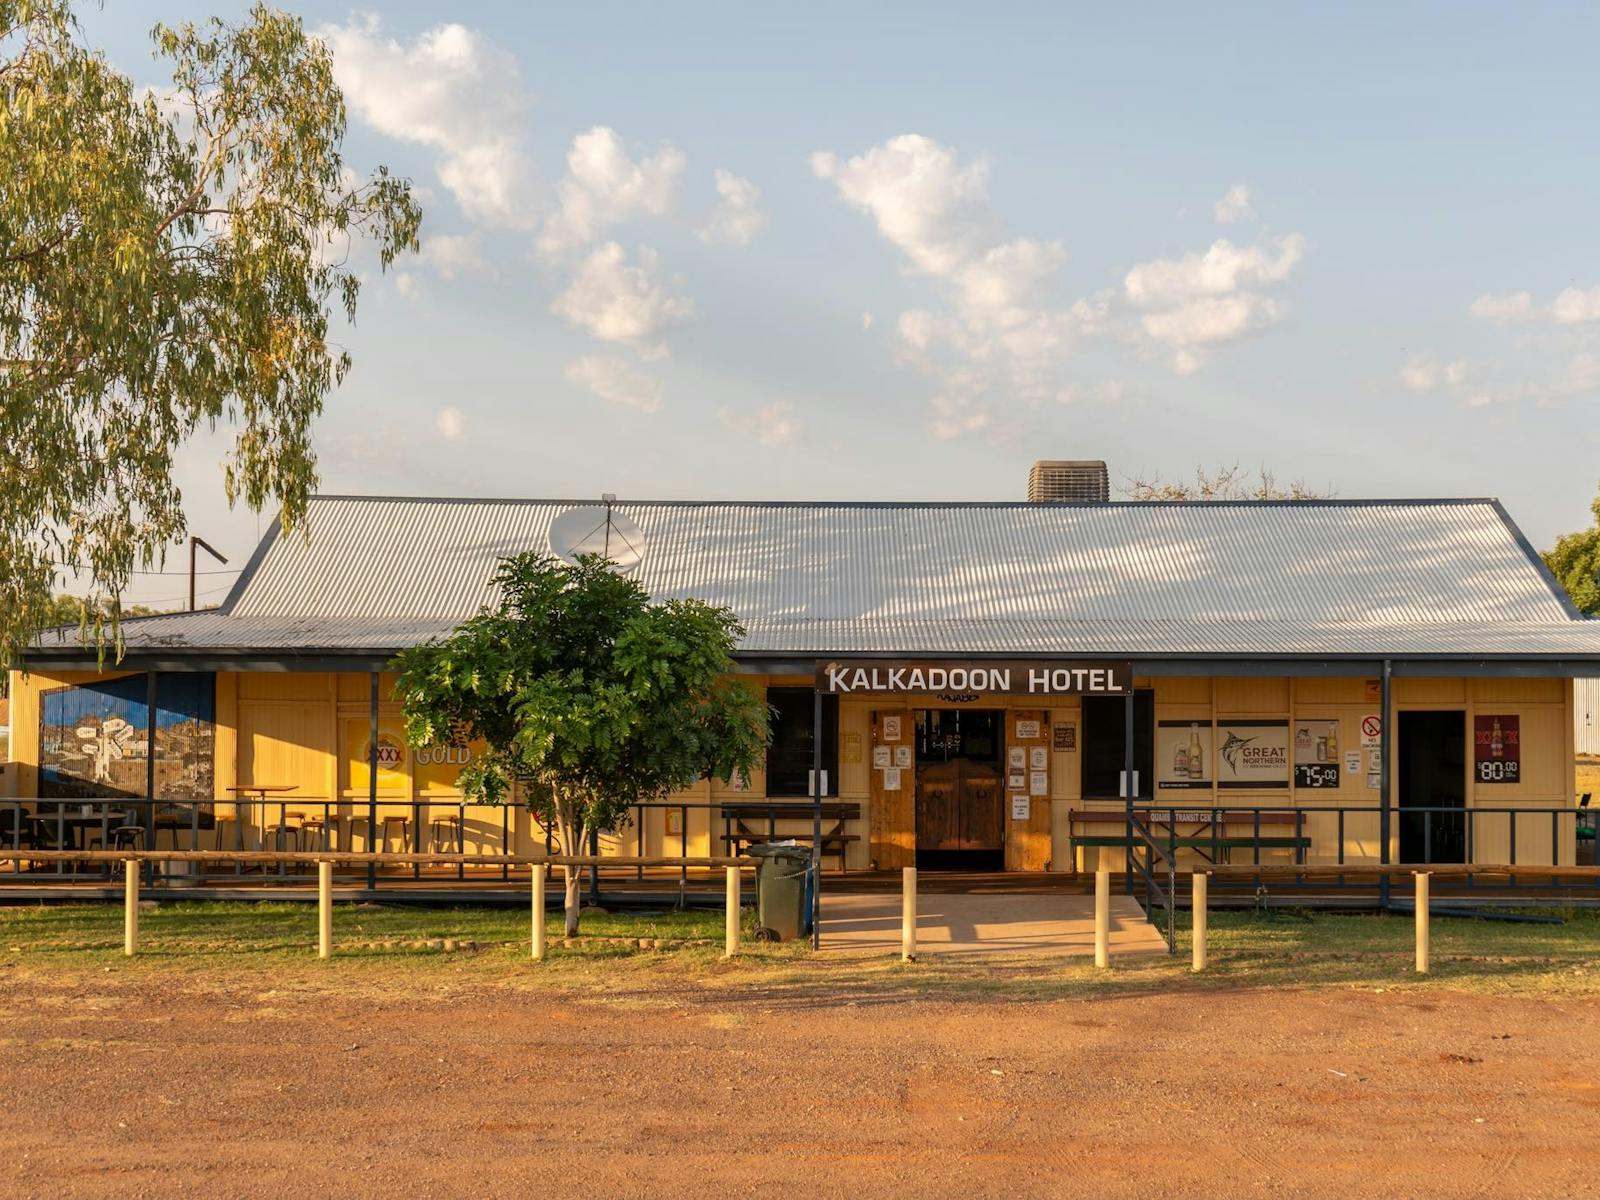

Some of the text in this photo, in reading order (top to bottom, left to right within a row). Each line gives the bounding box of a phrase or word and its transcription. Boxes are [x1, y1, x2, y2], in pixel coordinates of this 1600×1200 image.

[829, 668, 1123, 693] KALKADOON HOTEL
[416, 746, 471, 765] GOLD
[1242, 747, 1286, 757] GREAT
[1242, 757, 1286, 765] NORTHERN
[1150, 813, 1222, 822] QUAMB TRANSIT CENE
